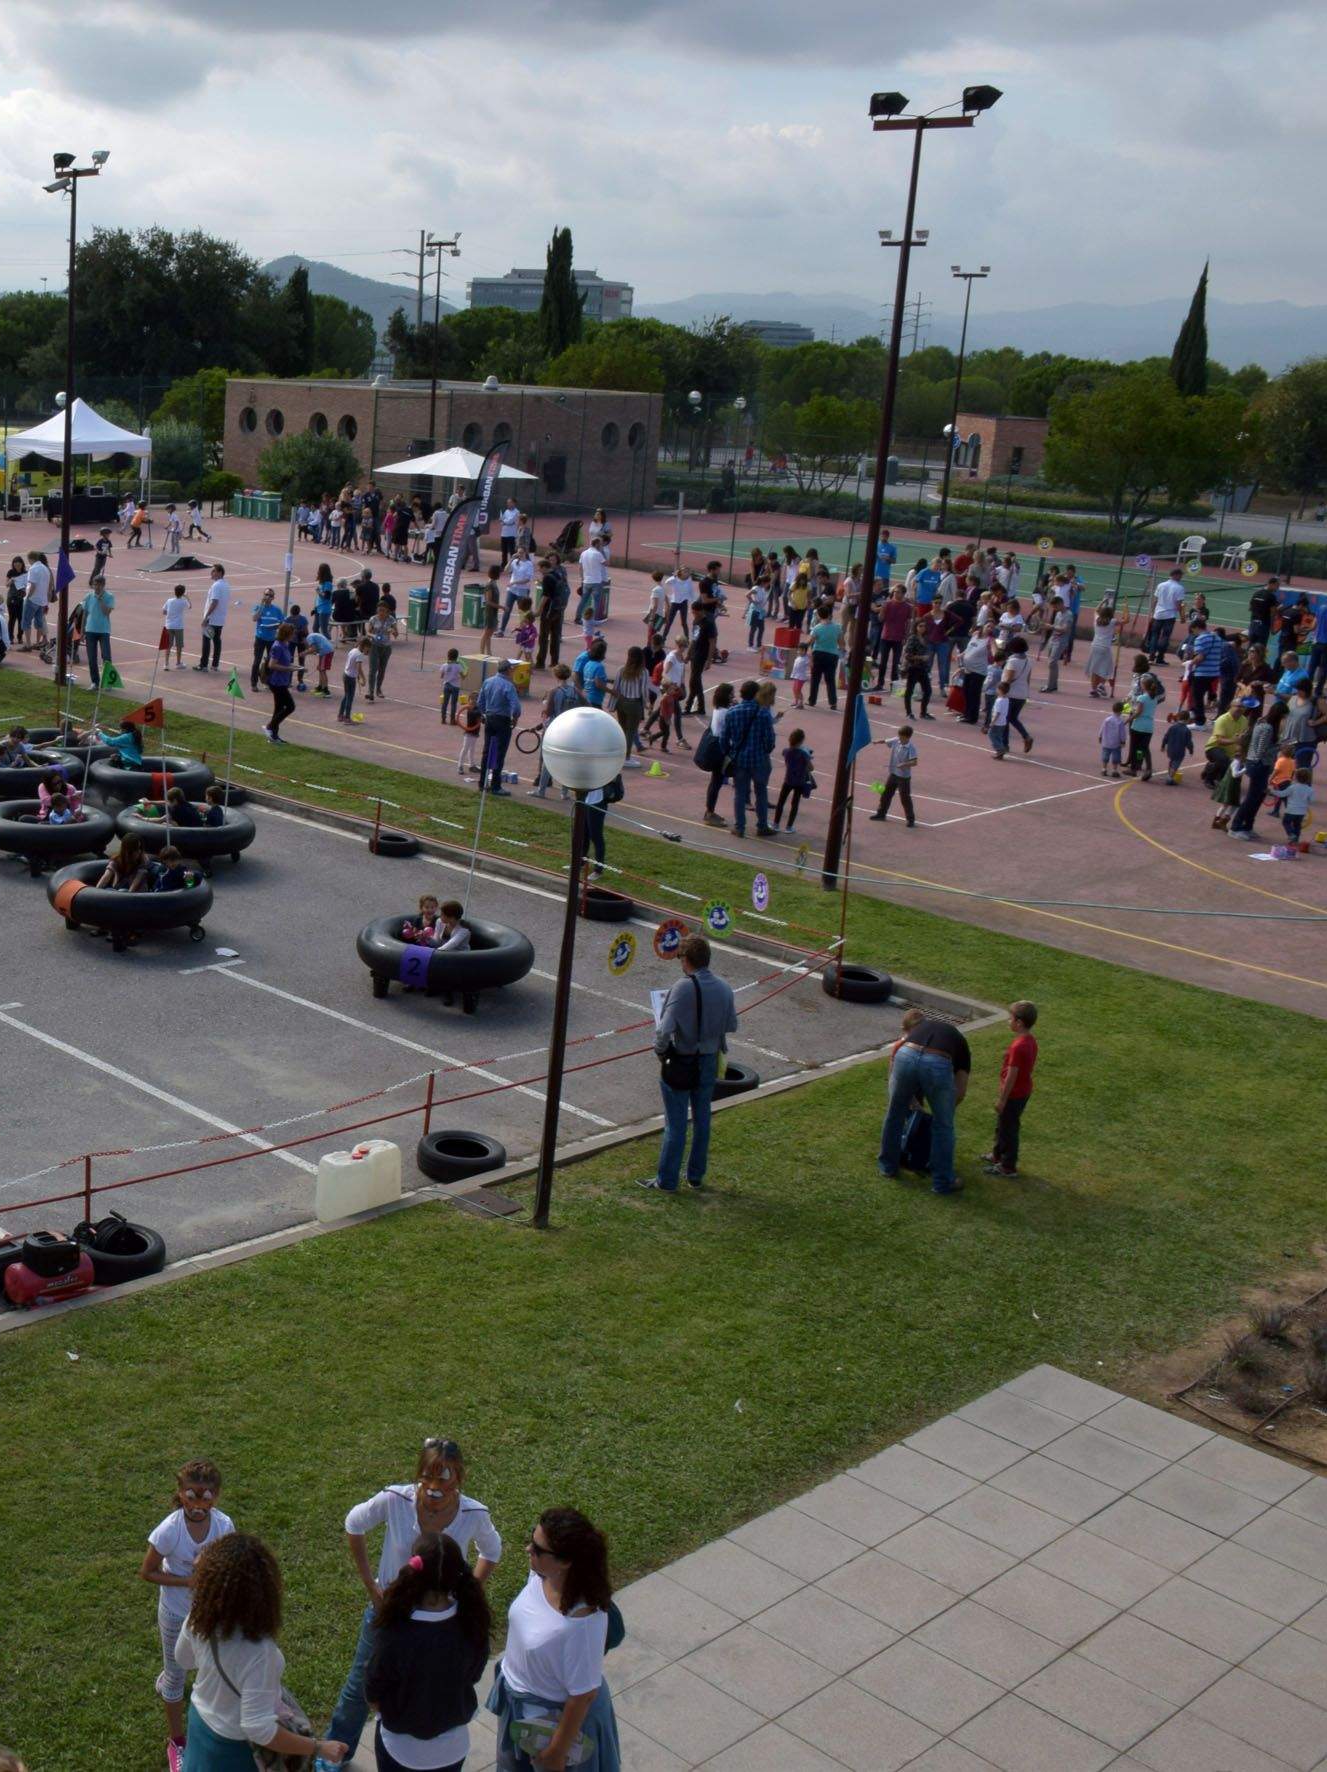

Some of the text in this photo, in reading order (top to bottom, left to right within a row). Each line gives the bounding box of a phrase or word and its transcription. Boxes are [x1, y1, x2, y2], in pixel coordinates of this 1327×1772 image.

[480, 476, 494, 510] URBAN
[442, 546, 459, 595] URBAN
[108, 670, 117, 685] 9
[144, 704, 156, 723] 5
[407, 957, 421, 976] 2
